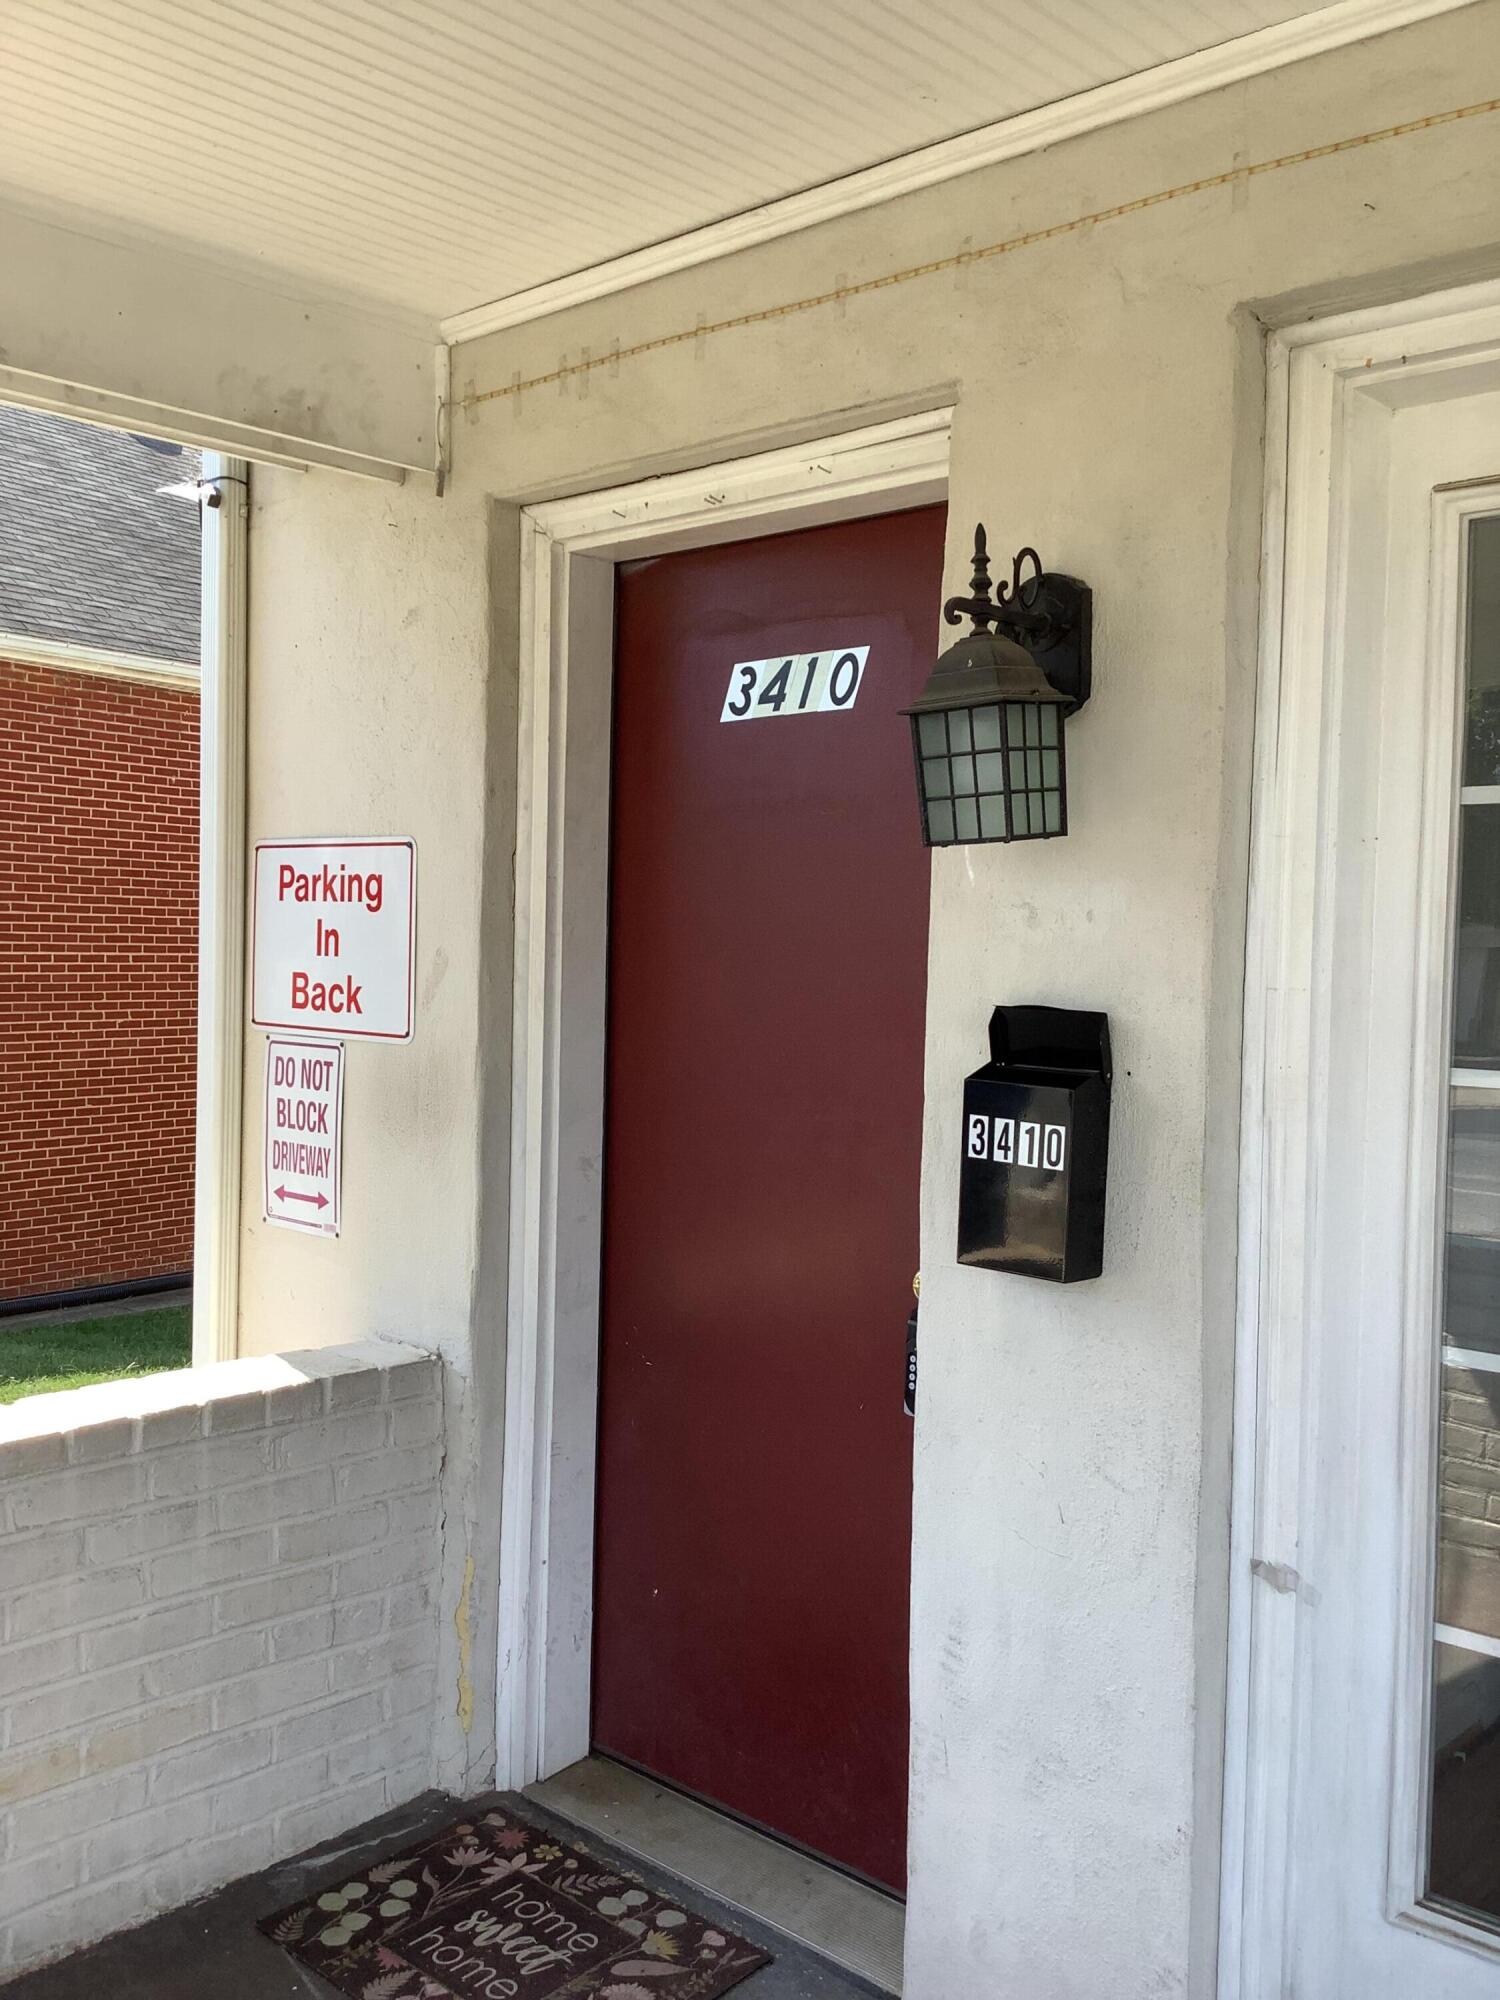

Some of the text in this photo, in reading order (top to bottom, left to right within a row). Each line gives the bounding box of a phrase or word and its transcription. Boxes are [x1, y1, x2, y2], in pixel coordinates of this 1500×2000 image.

[728, 652, 859, 716] 3410
[279, 864, 383, 912] Parking
[316, 918, 339, 957] In
[291, 971, 362, 1014] Back
[274, 1055, 333, 1091] DO NOT
[277, 1097, 328, 1134] BLOCK
[273, 1140, 331, 1178] DRIVEWAY
[971, 1118, 1062, 1167] 3410
[453, 1908, 576, 1976] sweet
[491, 1882, 599, 1954] home
[408, 1925, 519, 2000] home
